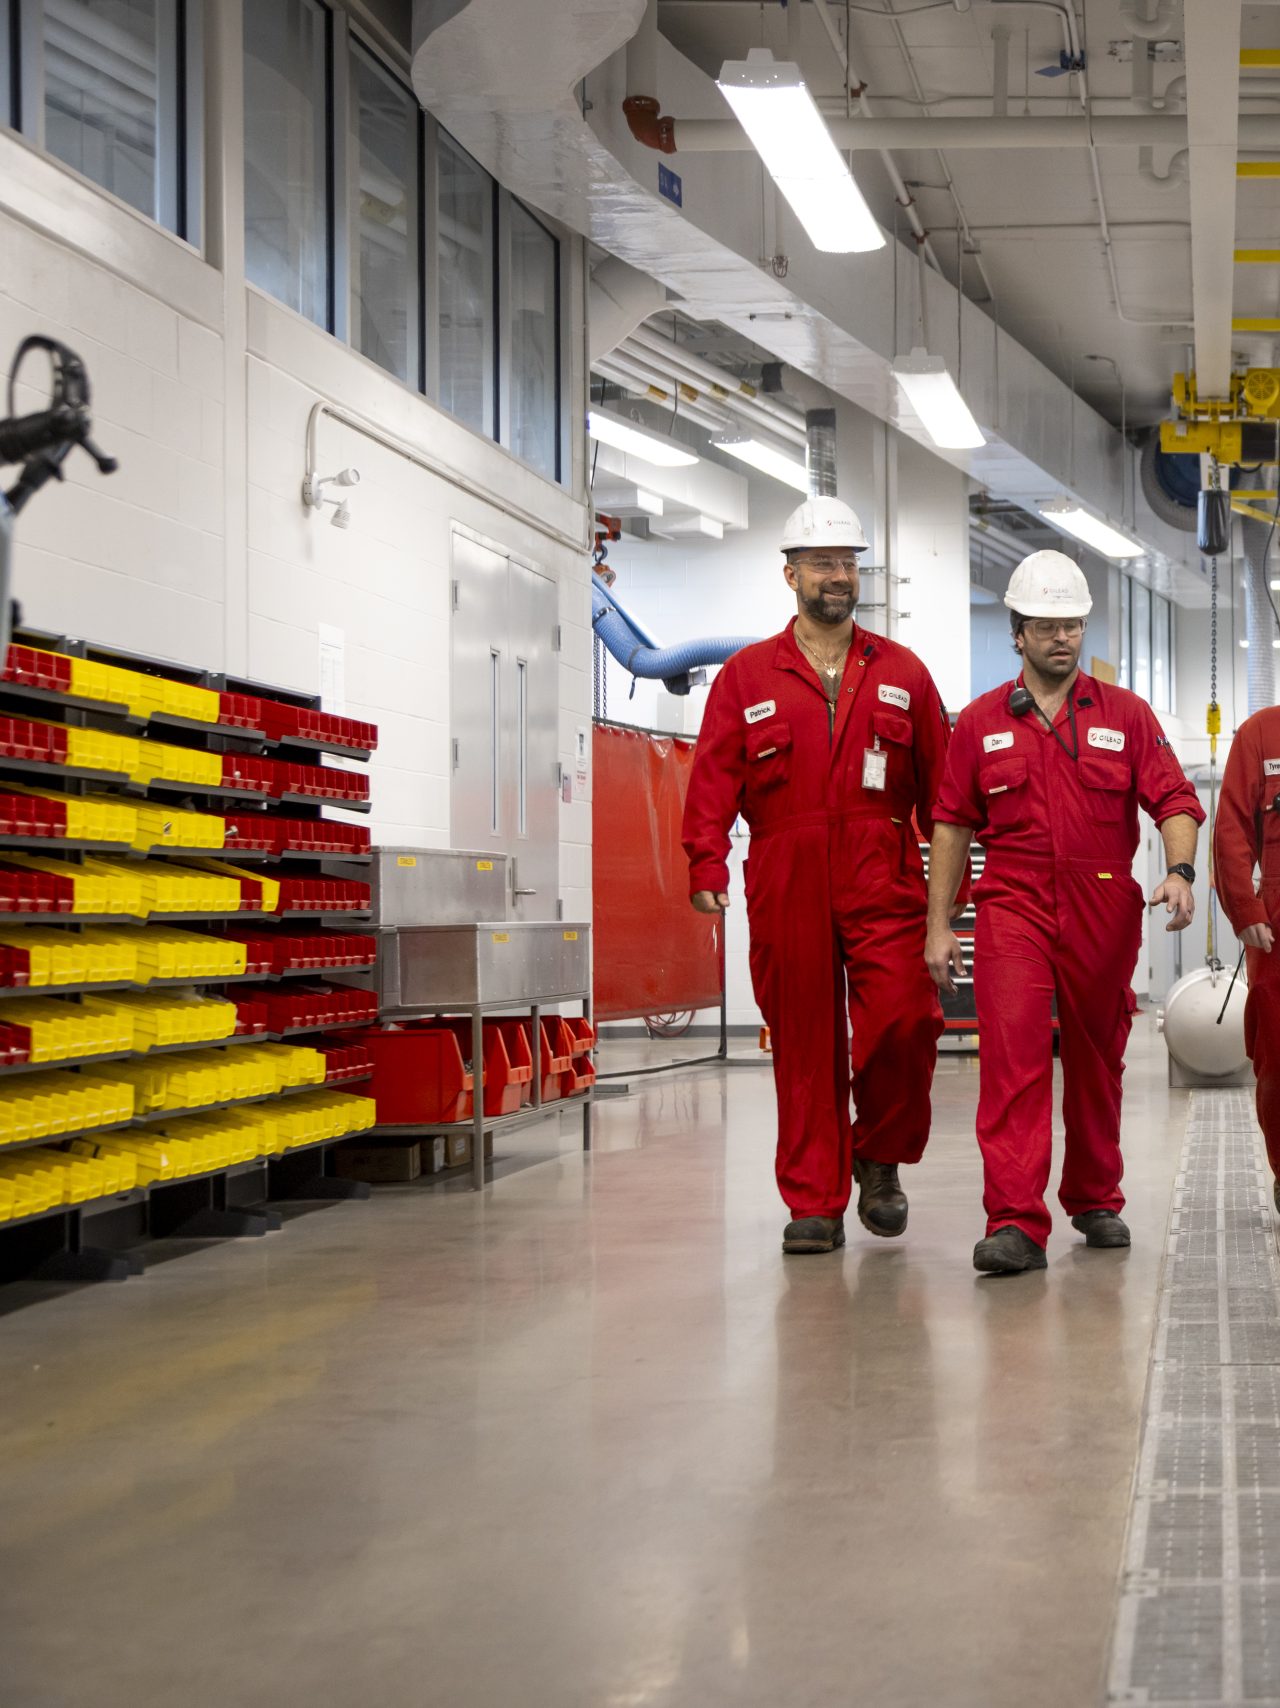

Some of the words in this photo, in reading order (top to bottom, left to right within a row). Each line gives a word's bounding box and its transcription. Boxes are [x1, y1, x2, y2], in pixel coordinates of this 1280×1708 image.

[888, 692, 908, 703] GILEAD
[749, 706, 771, 719] Patrick
[991, 738, 1003, 746] Dan
[1099, 735, 1122, 745] GILEAD
